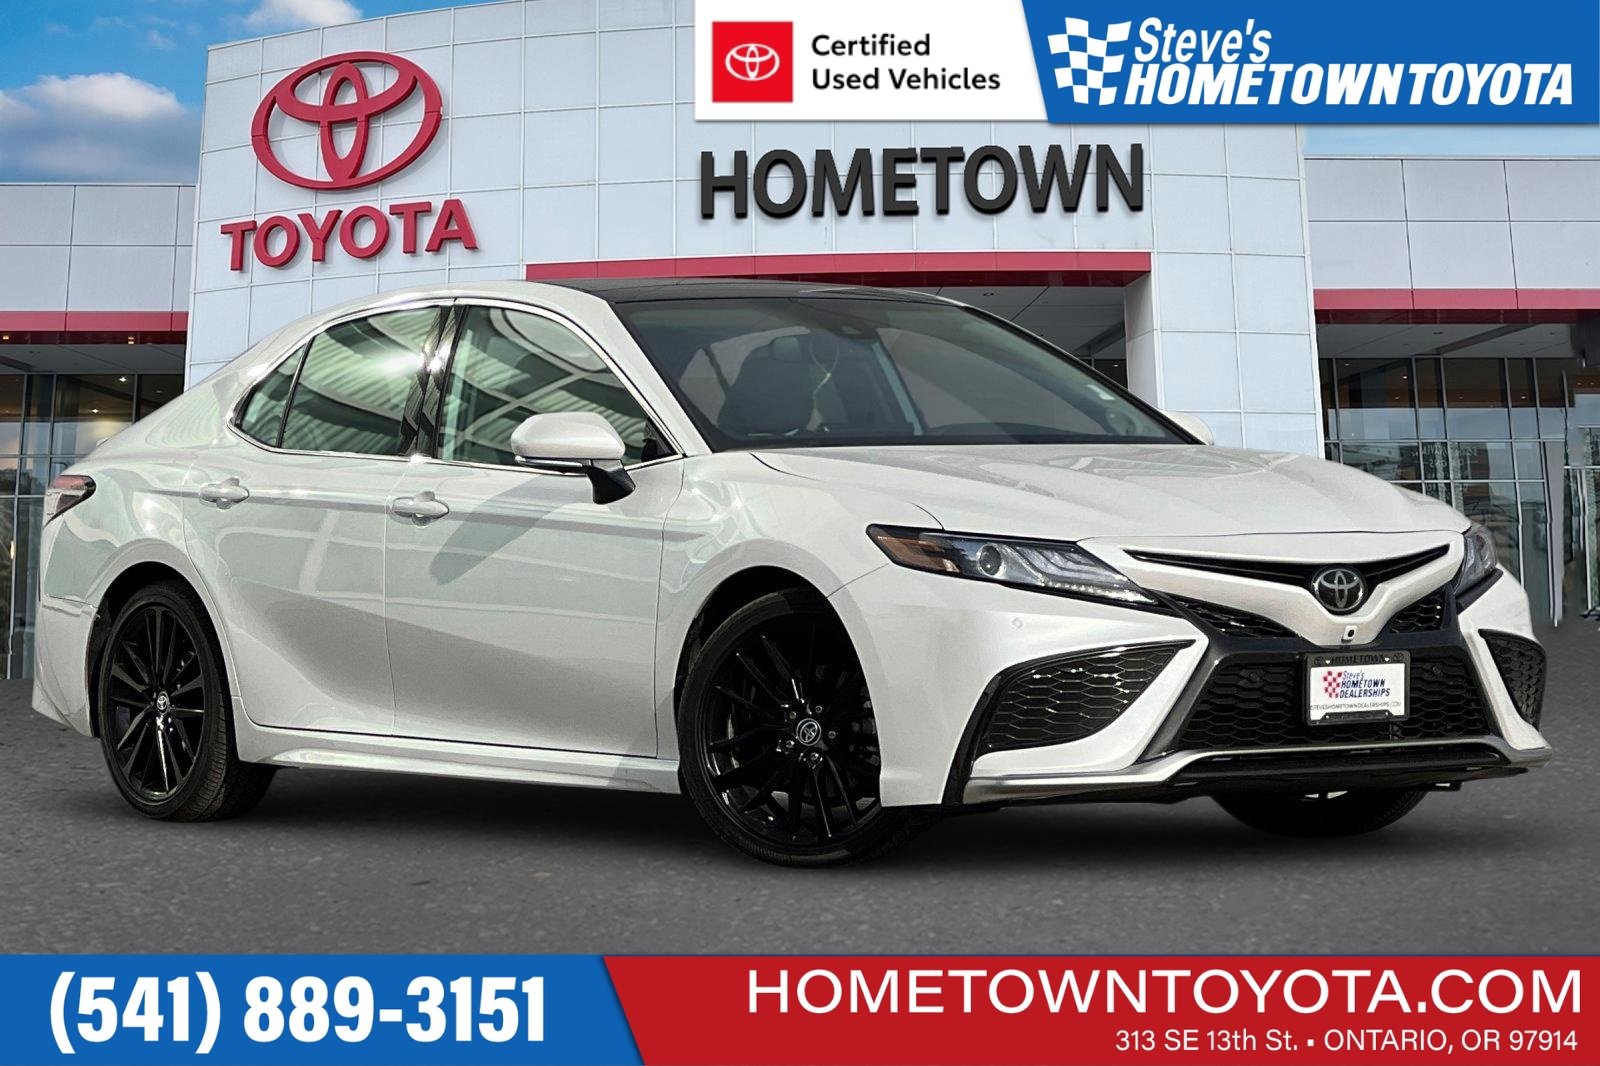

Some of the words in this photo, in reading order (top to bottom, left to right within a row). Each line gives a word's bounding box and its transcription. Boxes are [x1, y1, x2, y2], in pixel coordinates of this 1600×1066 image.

[700, 143, 1145, 219] HOMETOWN
[221, 198, 478, 271] TOYOTA
[1343, 670, 1365, 680] Steve's
[1340, 679, 1386, 689] HOMETOWN
[1340, 688, 1391, 699] DEALERSHIPS
